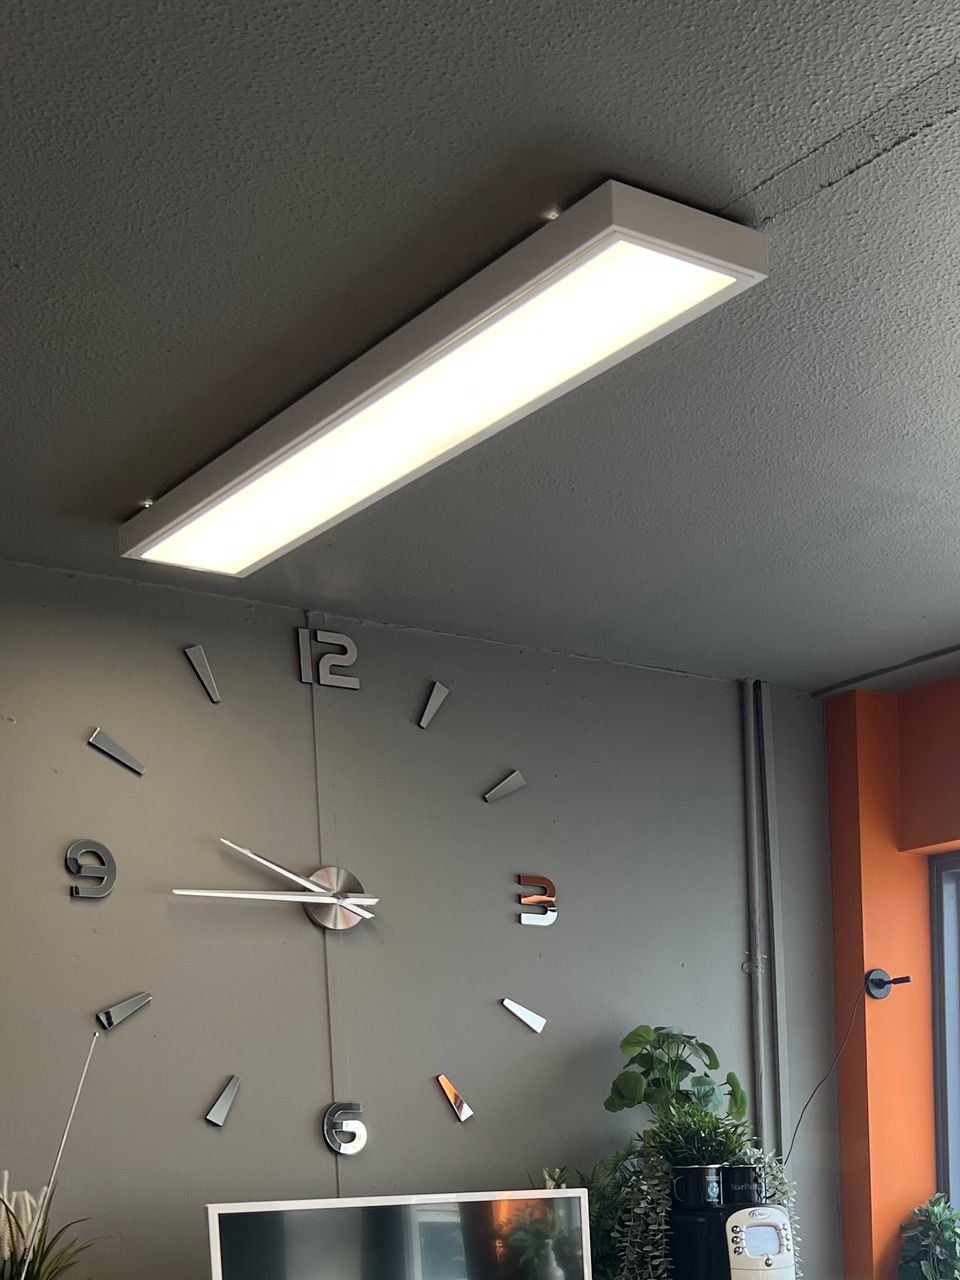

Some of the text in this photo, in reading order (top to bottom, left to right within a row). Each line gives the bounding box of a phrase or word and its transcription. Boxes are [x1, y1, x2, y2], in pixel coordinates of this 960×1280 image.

[298, 627, 361, 690] 12
[65, 839, 117, 899] 9
[518, 873, 559, 926] 3
[323, 1101, 368, 1156] 6
